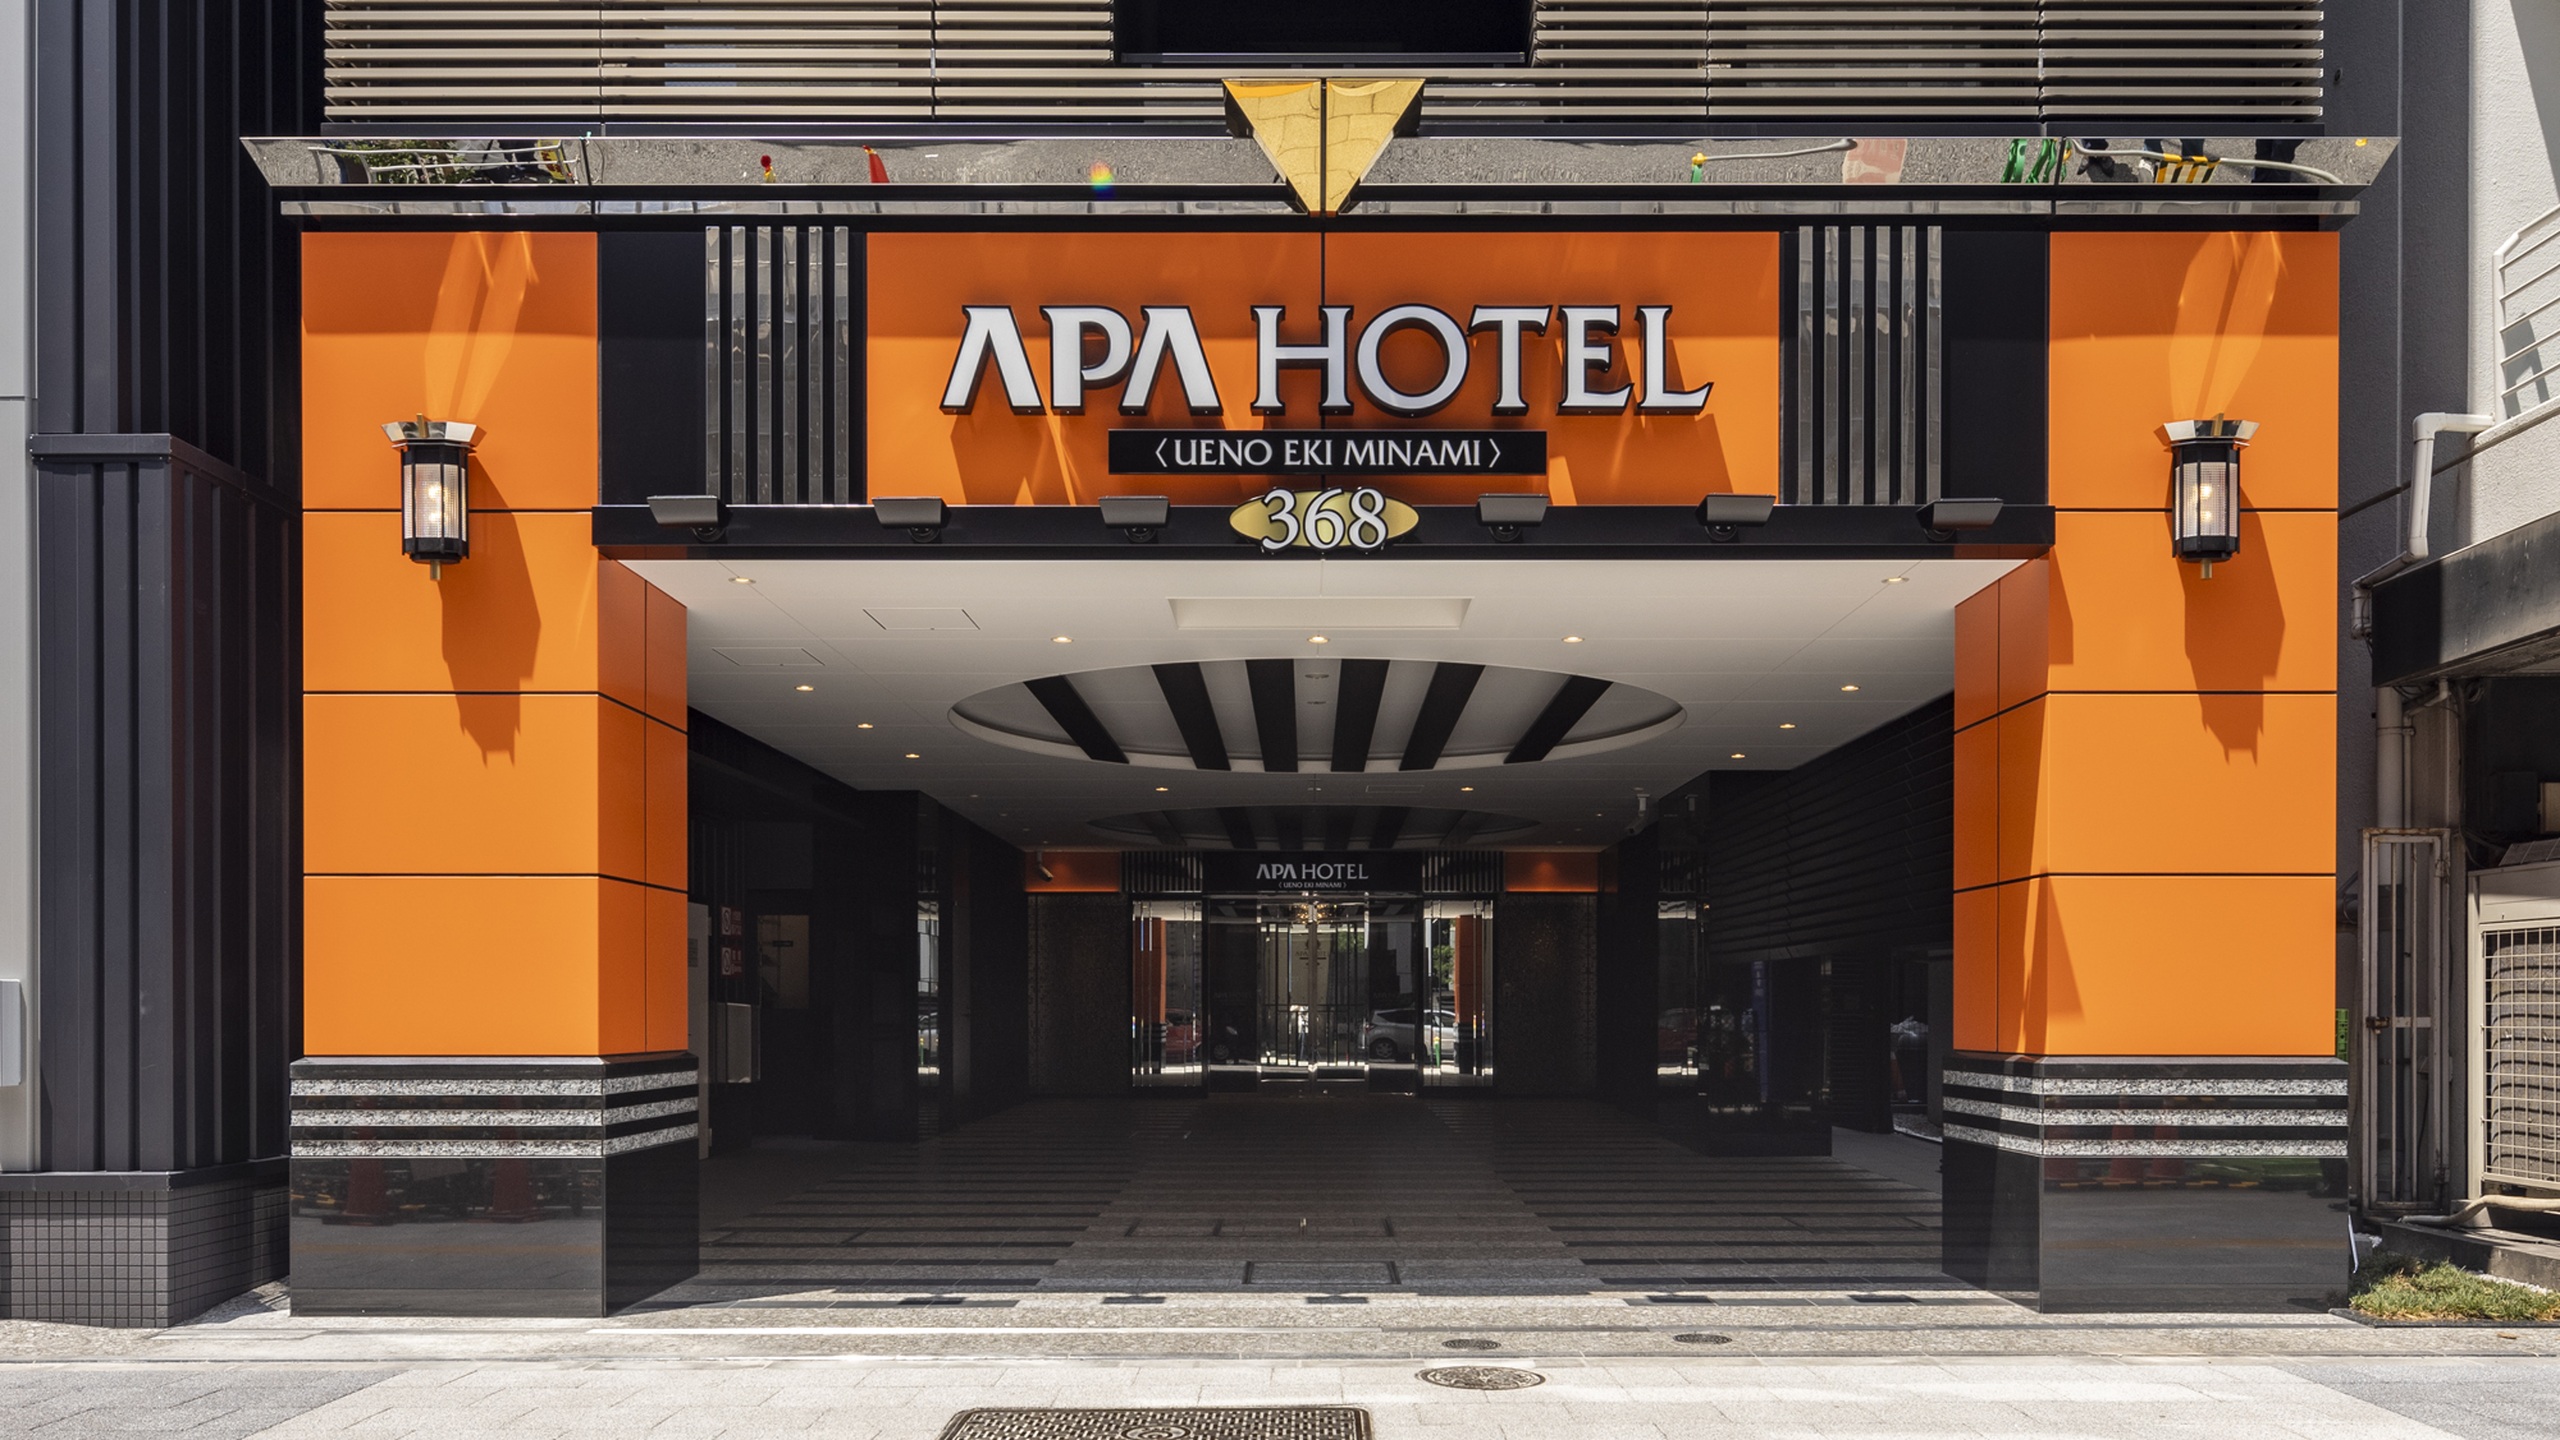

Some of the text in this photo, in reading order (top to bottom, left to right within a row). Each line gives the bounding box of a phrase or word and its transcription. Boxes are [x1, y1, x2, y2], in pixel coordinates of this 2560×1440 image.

[939, 304, 1714, 417] APA HOTEL
[1283, 438, 1332, 467] EKI
[1261, 486, 1388, 551] 368
[1256, 863, 1369, 880] APA HOTEL
